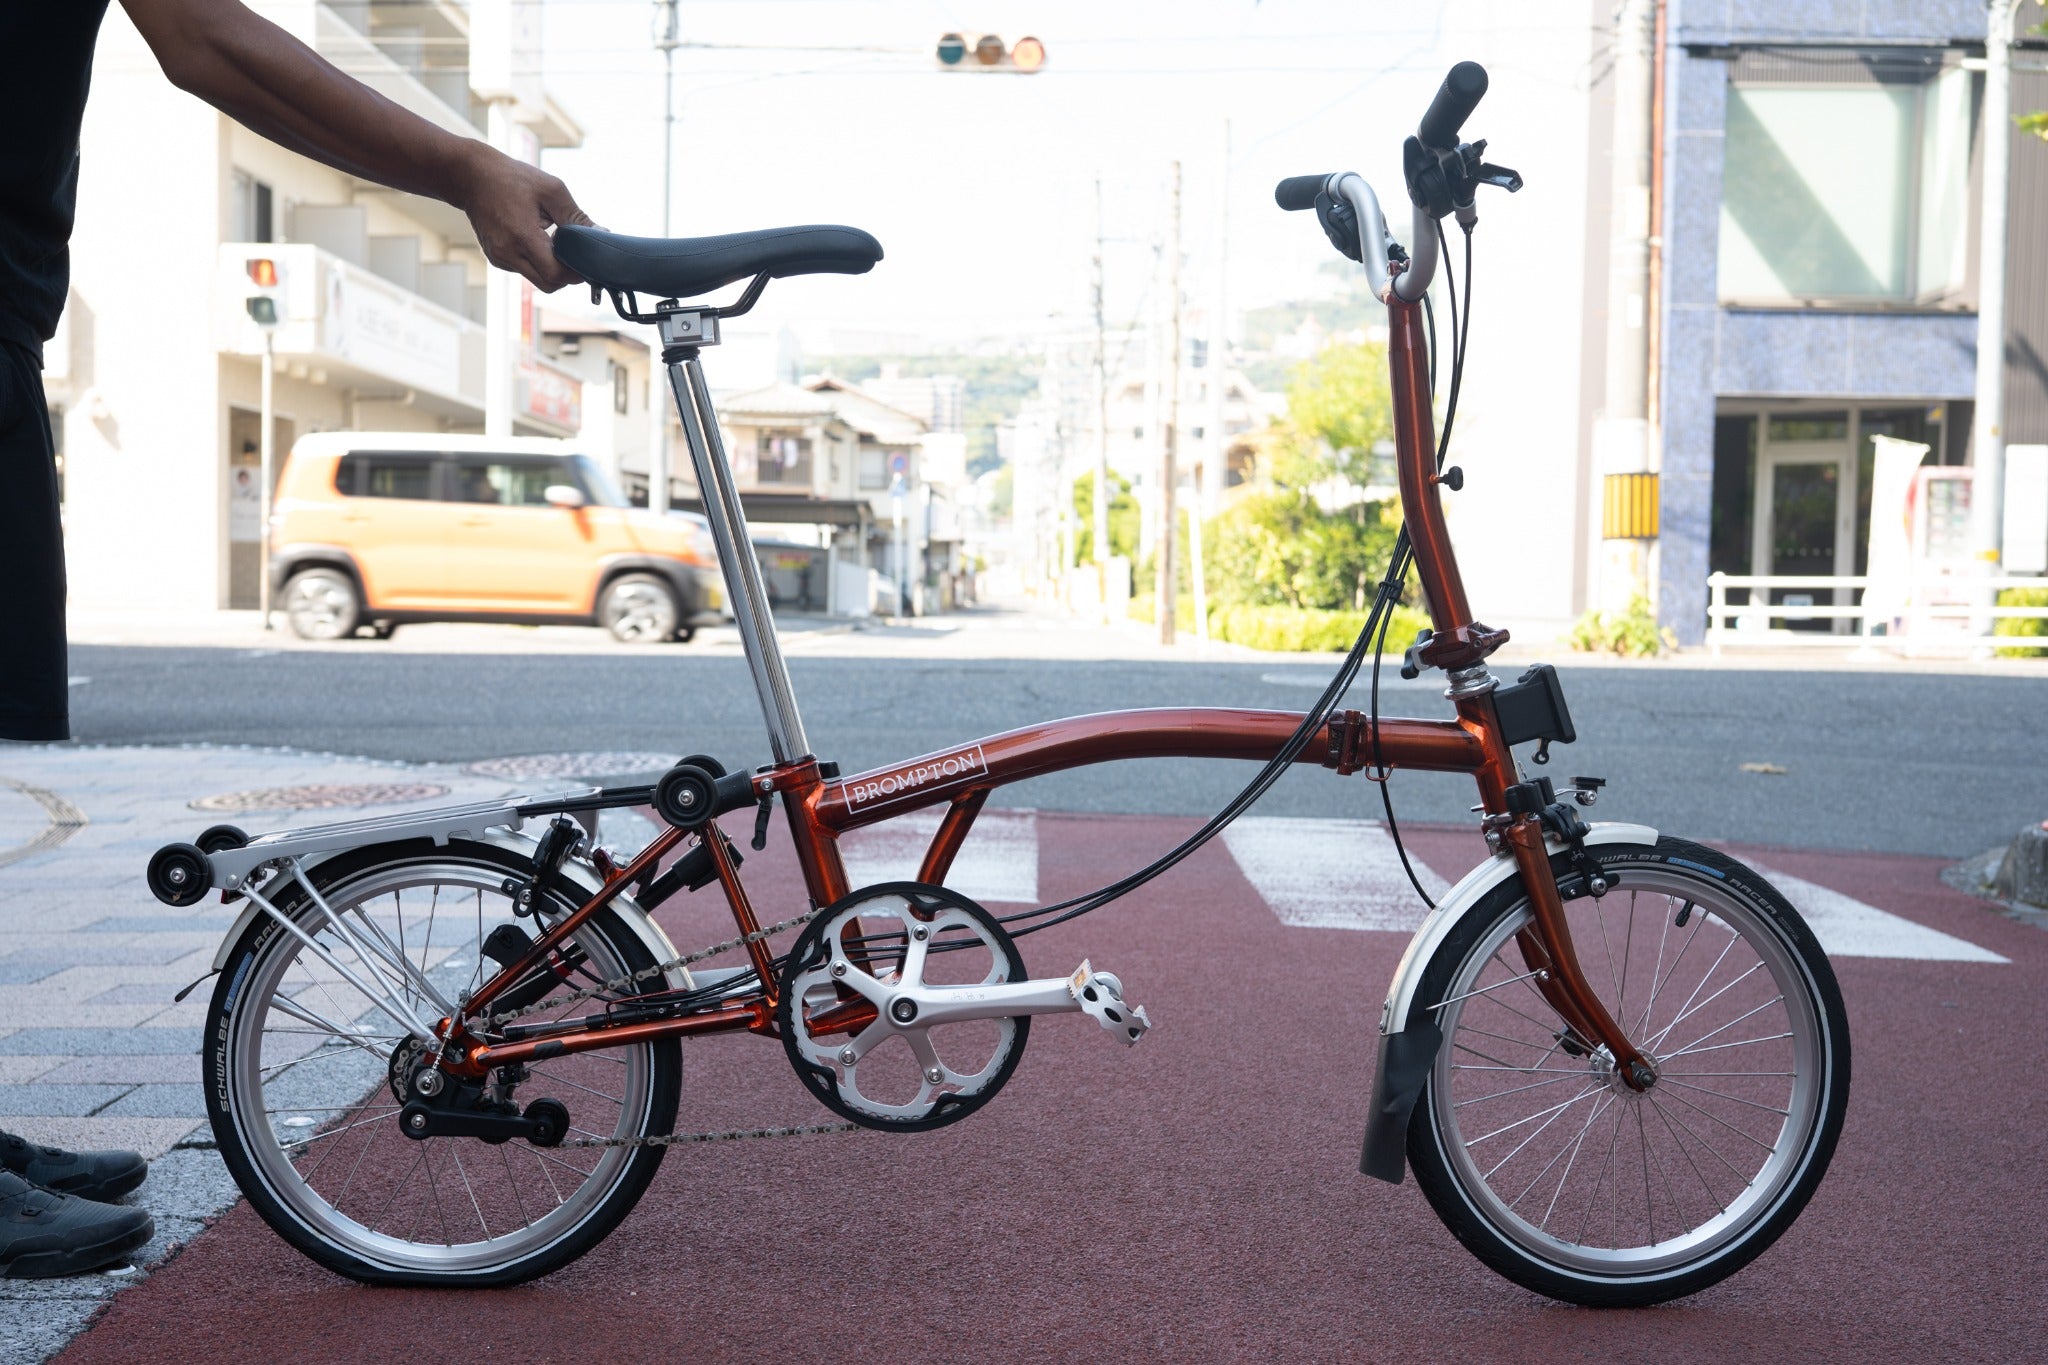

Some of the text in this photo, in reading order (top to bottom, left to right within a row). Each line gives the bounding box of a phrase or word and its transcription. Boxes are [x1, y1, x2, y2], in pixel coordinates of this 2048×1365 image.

[853, 753, 976, 803] BROMPTON
[1596, 854, 1777, 914] HWALBE RACER
[216, 1016, 230, 1112] SCHWALBE
